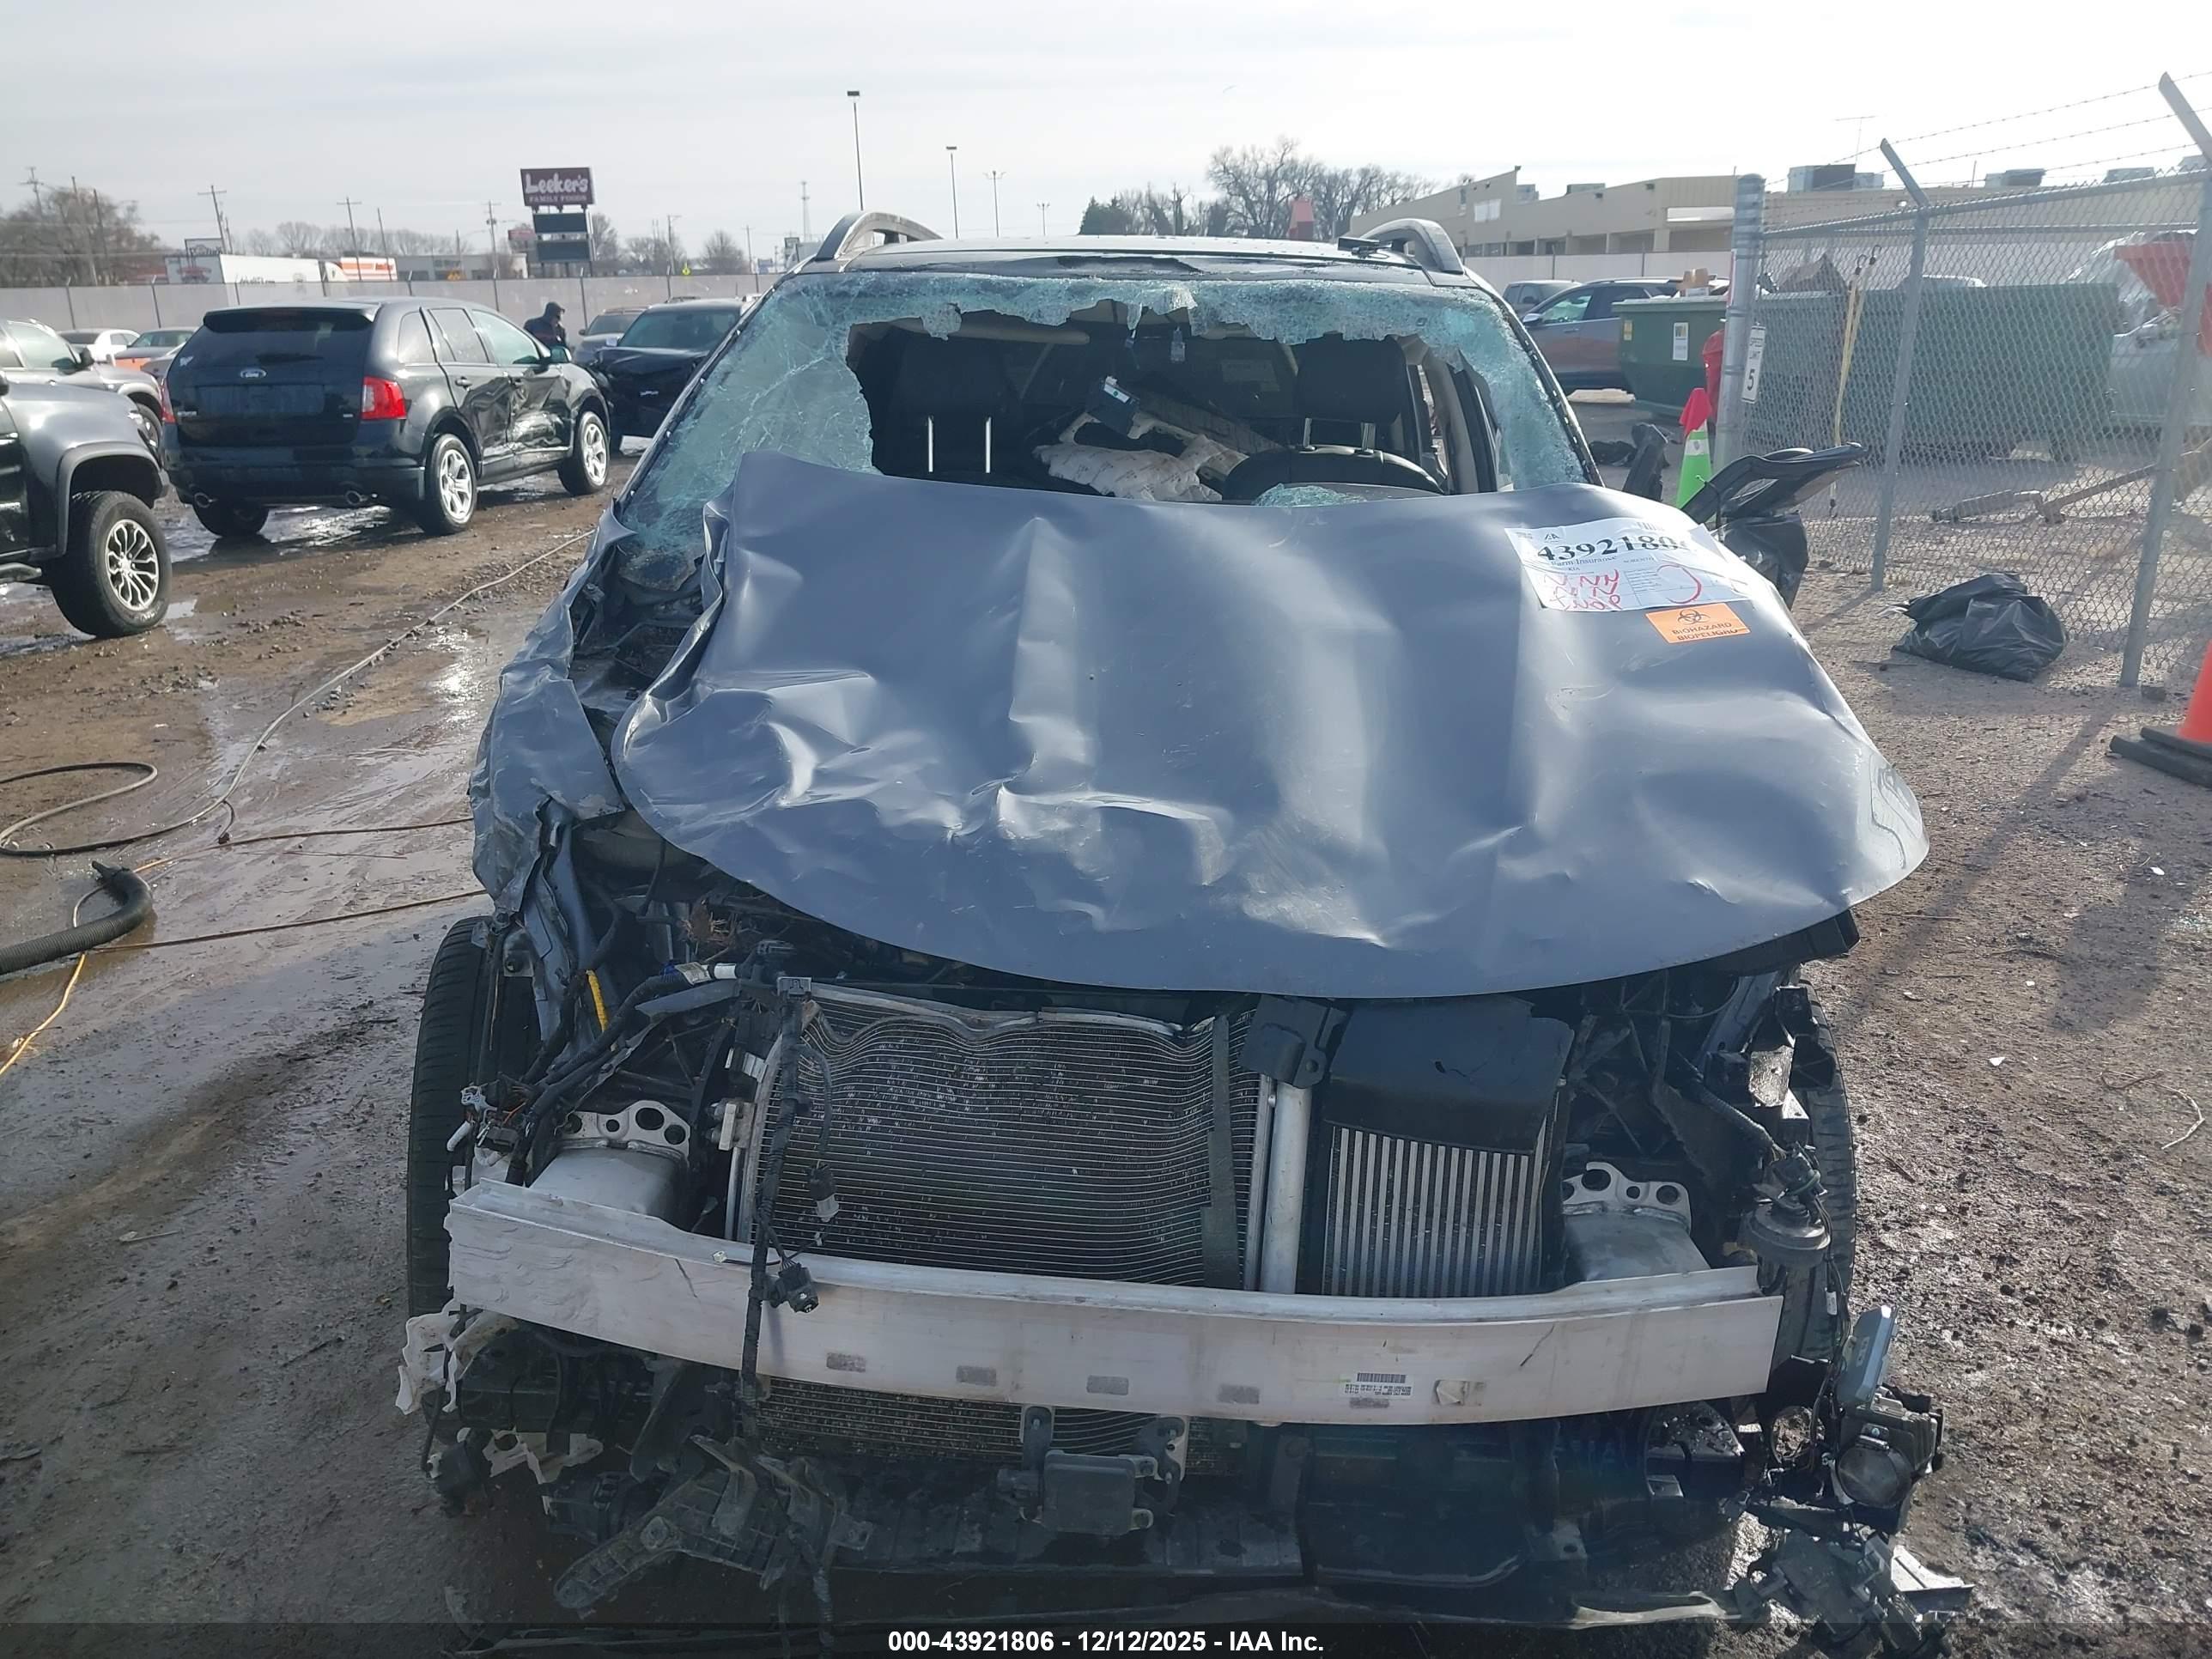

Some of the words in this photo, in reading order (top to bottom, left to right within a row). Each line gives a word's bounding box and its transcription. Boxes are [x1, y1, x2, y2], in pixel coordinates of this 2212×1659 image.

[526, 173, 588, 193] Leeker's
[1747, 368, 1755, 391] 5
[1538, 535, 1688, 561] 4392180
[1672, 622, 1732, 635] BIOHAZARD
[1677, 629, 1738, 640] BIOPELIGRO
